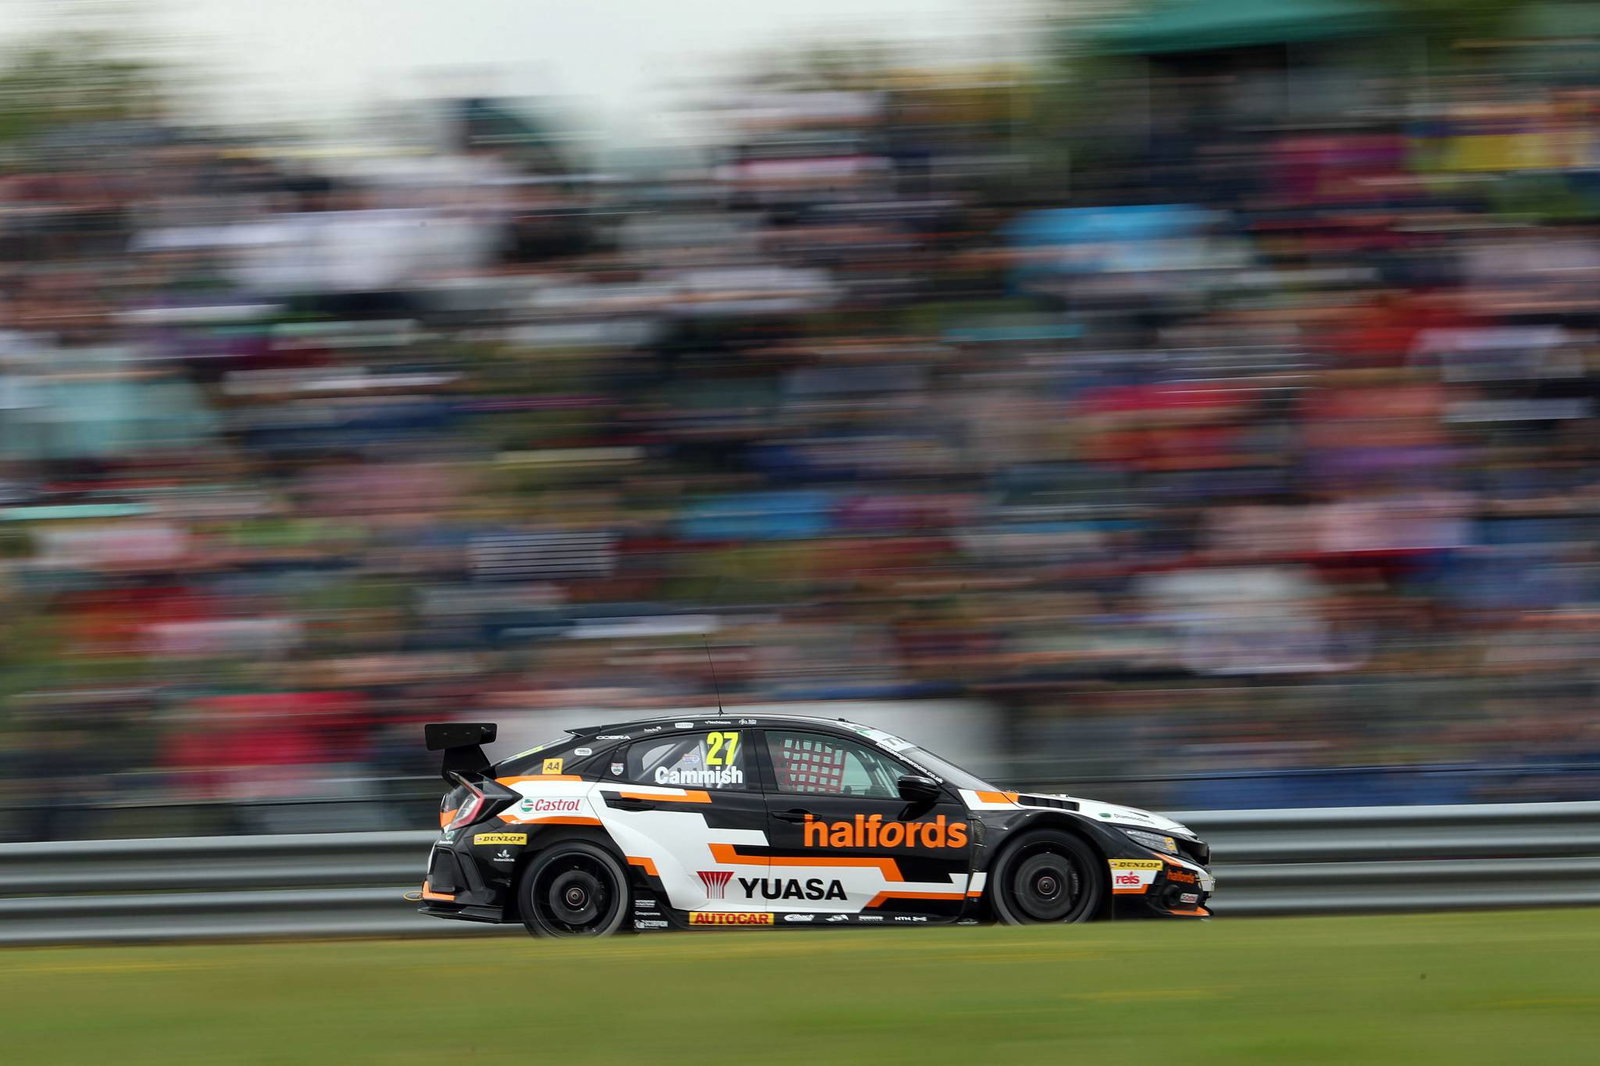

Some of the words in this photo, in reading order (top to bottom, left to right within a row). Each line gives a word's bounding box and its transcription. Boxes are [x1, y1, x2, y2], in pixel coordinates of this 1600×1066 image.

[706, 731, 739, 766] 27
[545, 762, 561, 771] AA
[654, 766, 743, 785] Cammish
[534, 799, 581, 811] Castrol
[804, 813, 968, 848] halfords
[1116, 871, 1140, 884] reis
[738, 878, 848, 901] YUASA
[694, 912, 769, 925] AUTOCAR
